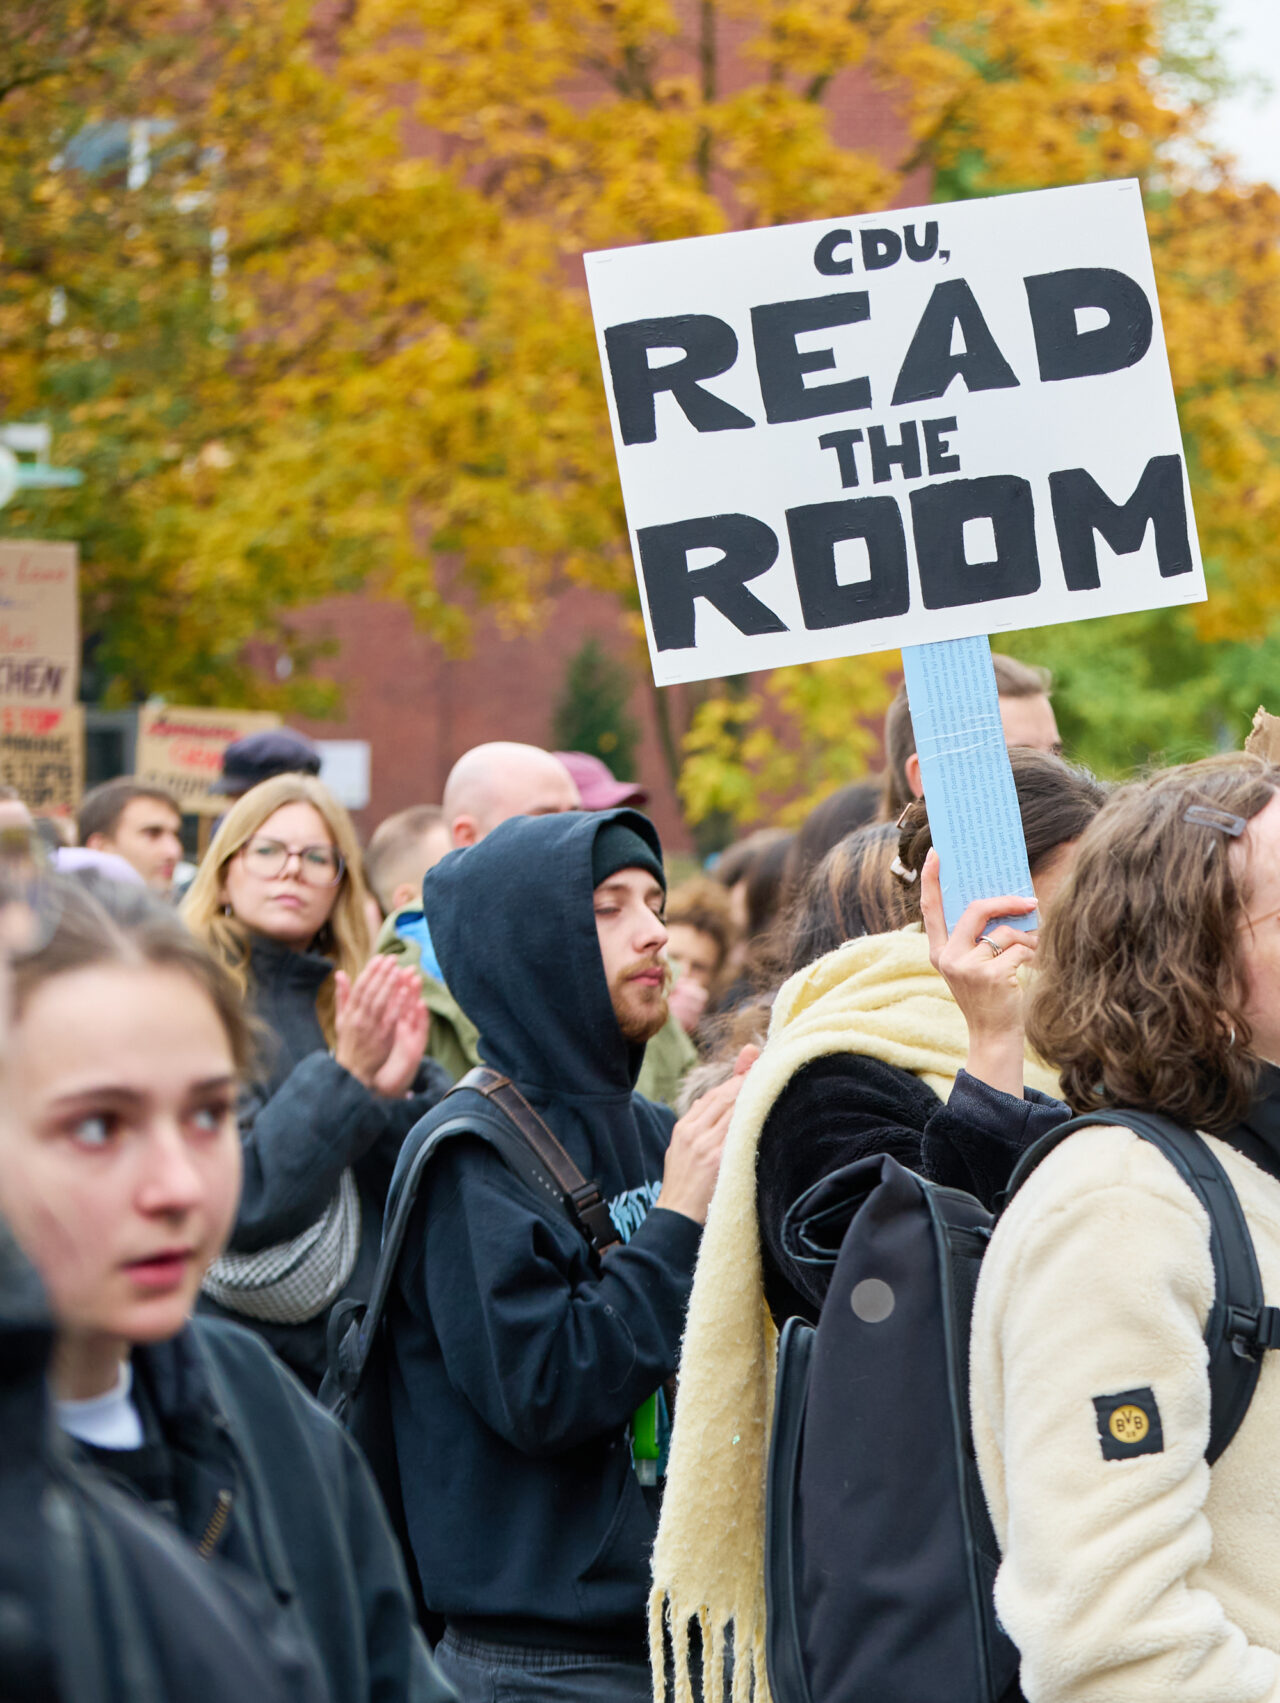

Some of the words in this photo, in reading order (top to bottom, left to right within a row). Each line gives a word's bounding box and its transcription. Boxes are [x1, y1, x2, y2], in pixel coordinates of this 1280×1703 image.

[813, 221, 951, 276] CDU,
[604, 267, 1153, 446] READ
[818, 416, 961, 488] THE
[637, 454, 1193, 651] ROOM
[1116, 1410, 1143, 1432] BVB
